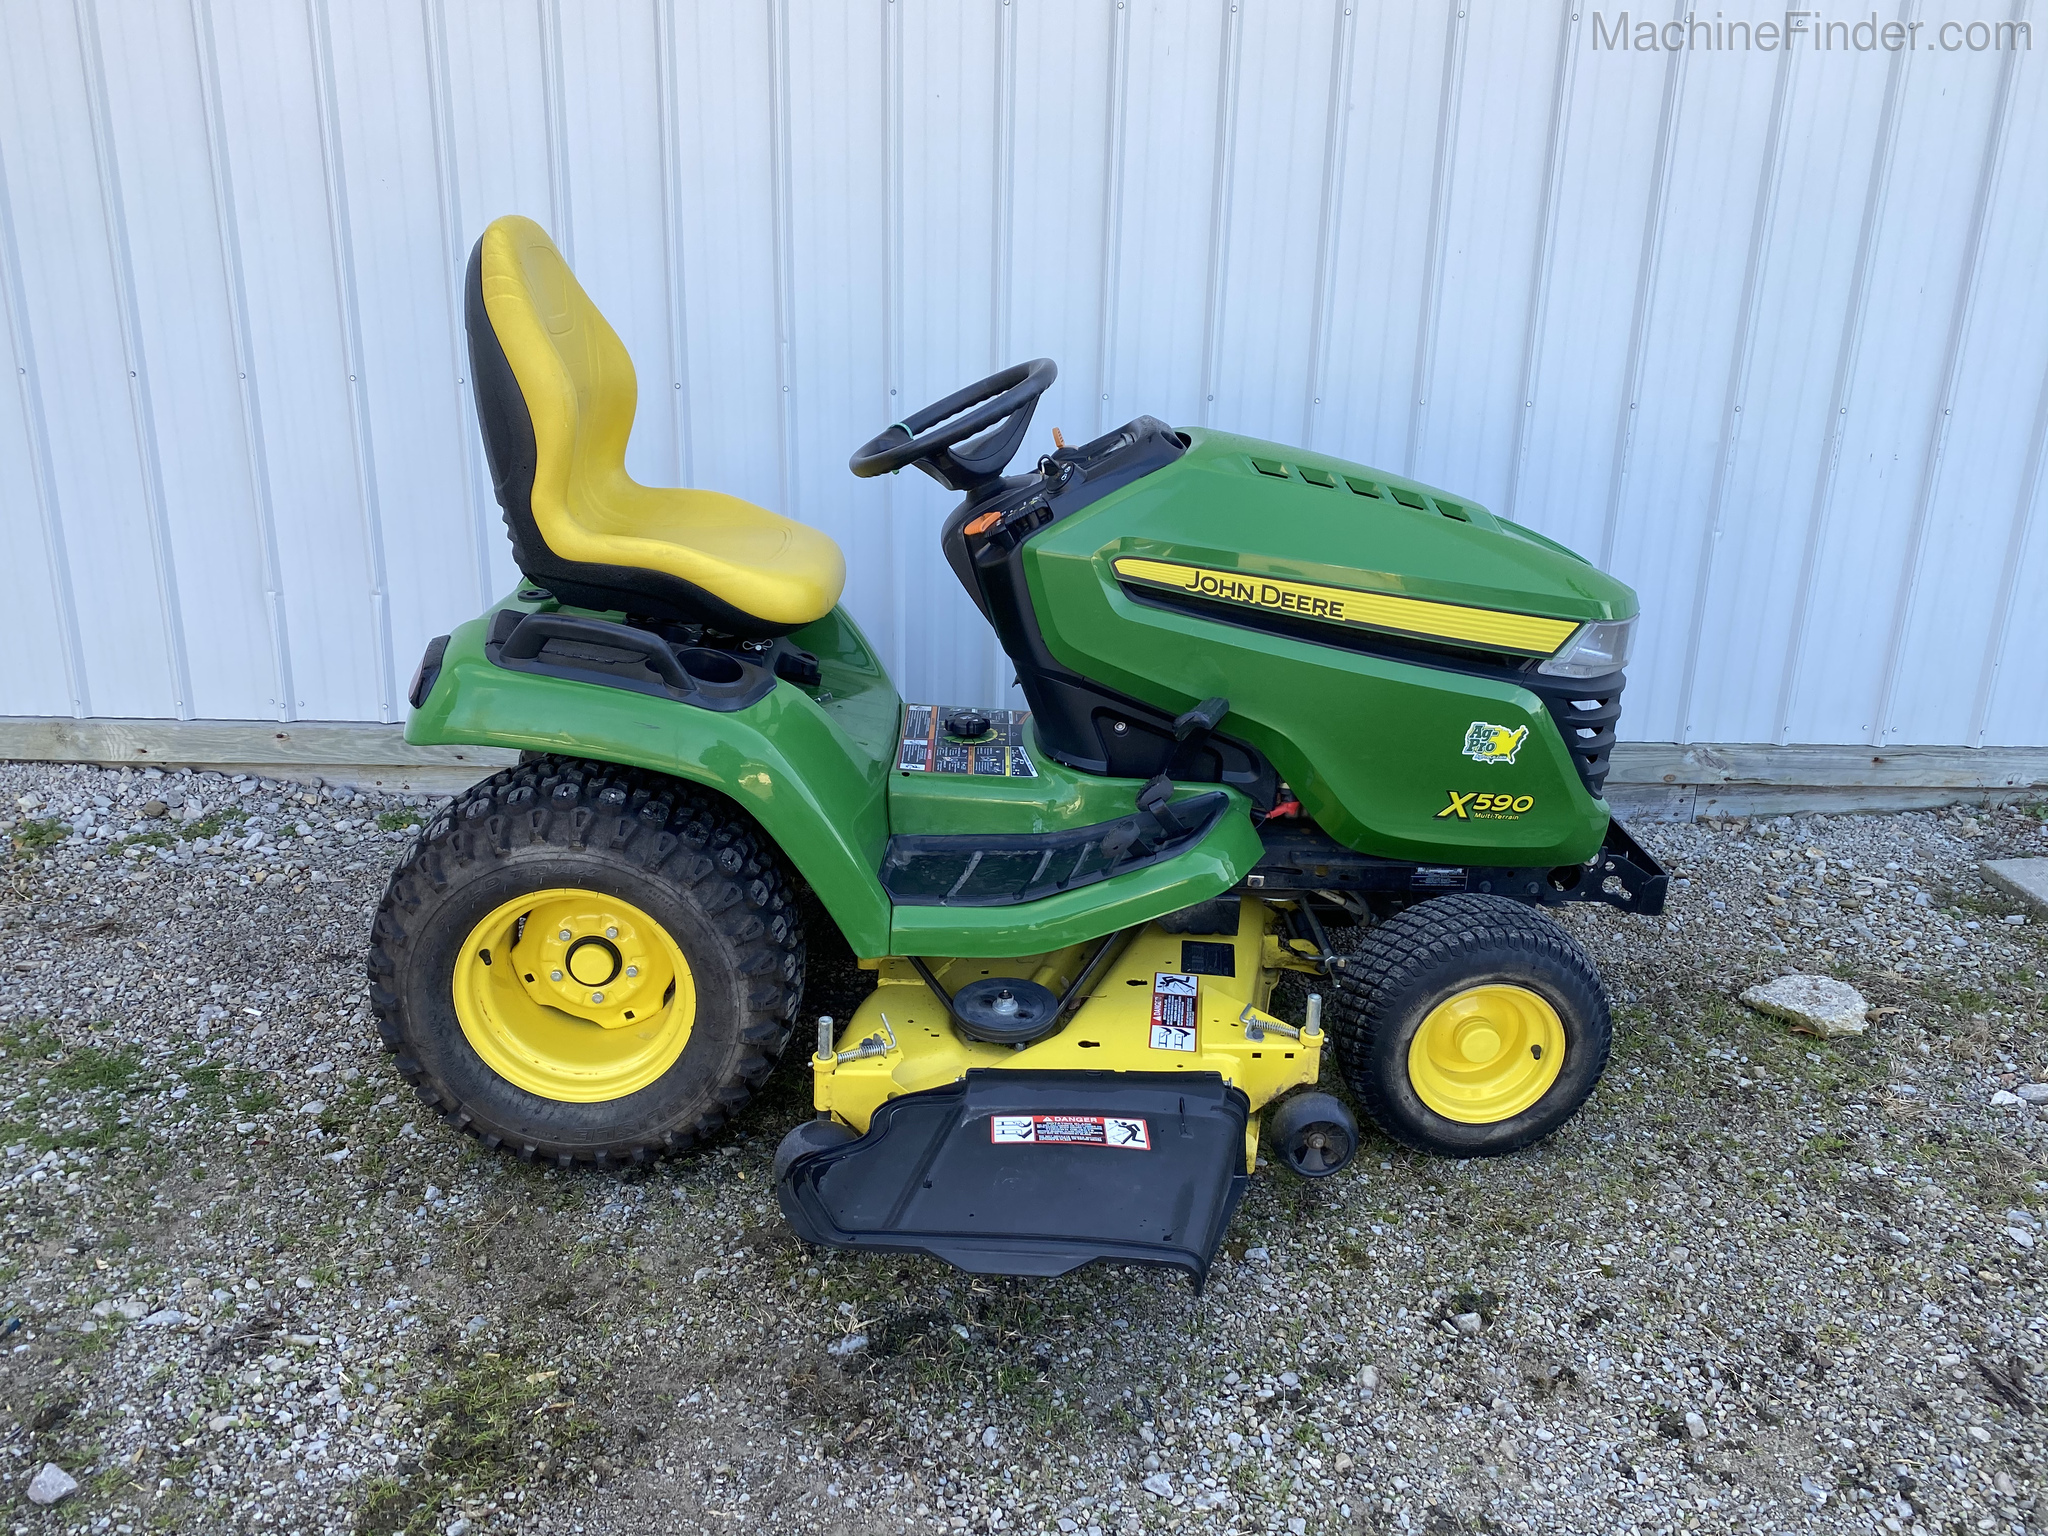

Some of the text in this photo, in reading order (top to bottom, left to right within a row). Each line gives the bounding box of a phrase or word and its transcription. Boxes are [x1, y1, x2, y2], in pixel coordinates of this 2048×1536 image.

[1185, 571, 1345, 619] JOHN DEERE
[1469, 725, 1499, 741] Ag-
[1466, 739, 1496, 752] Pro
[1435, 791, 1534, 819] X590
[1474, 812, 1519, 820] Multi-Terrain
